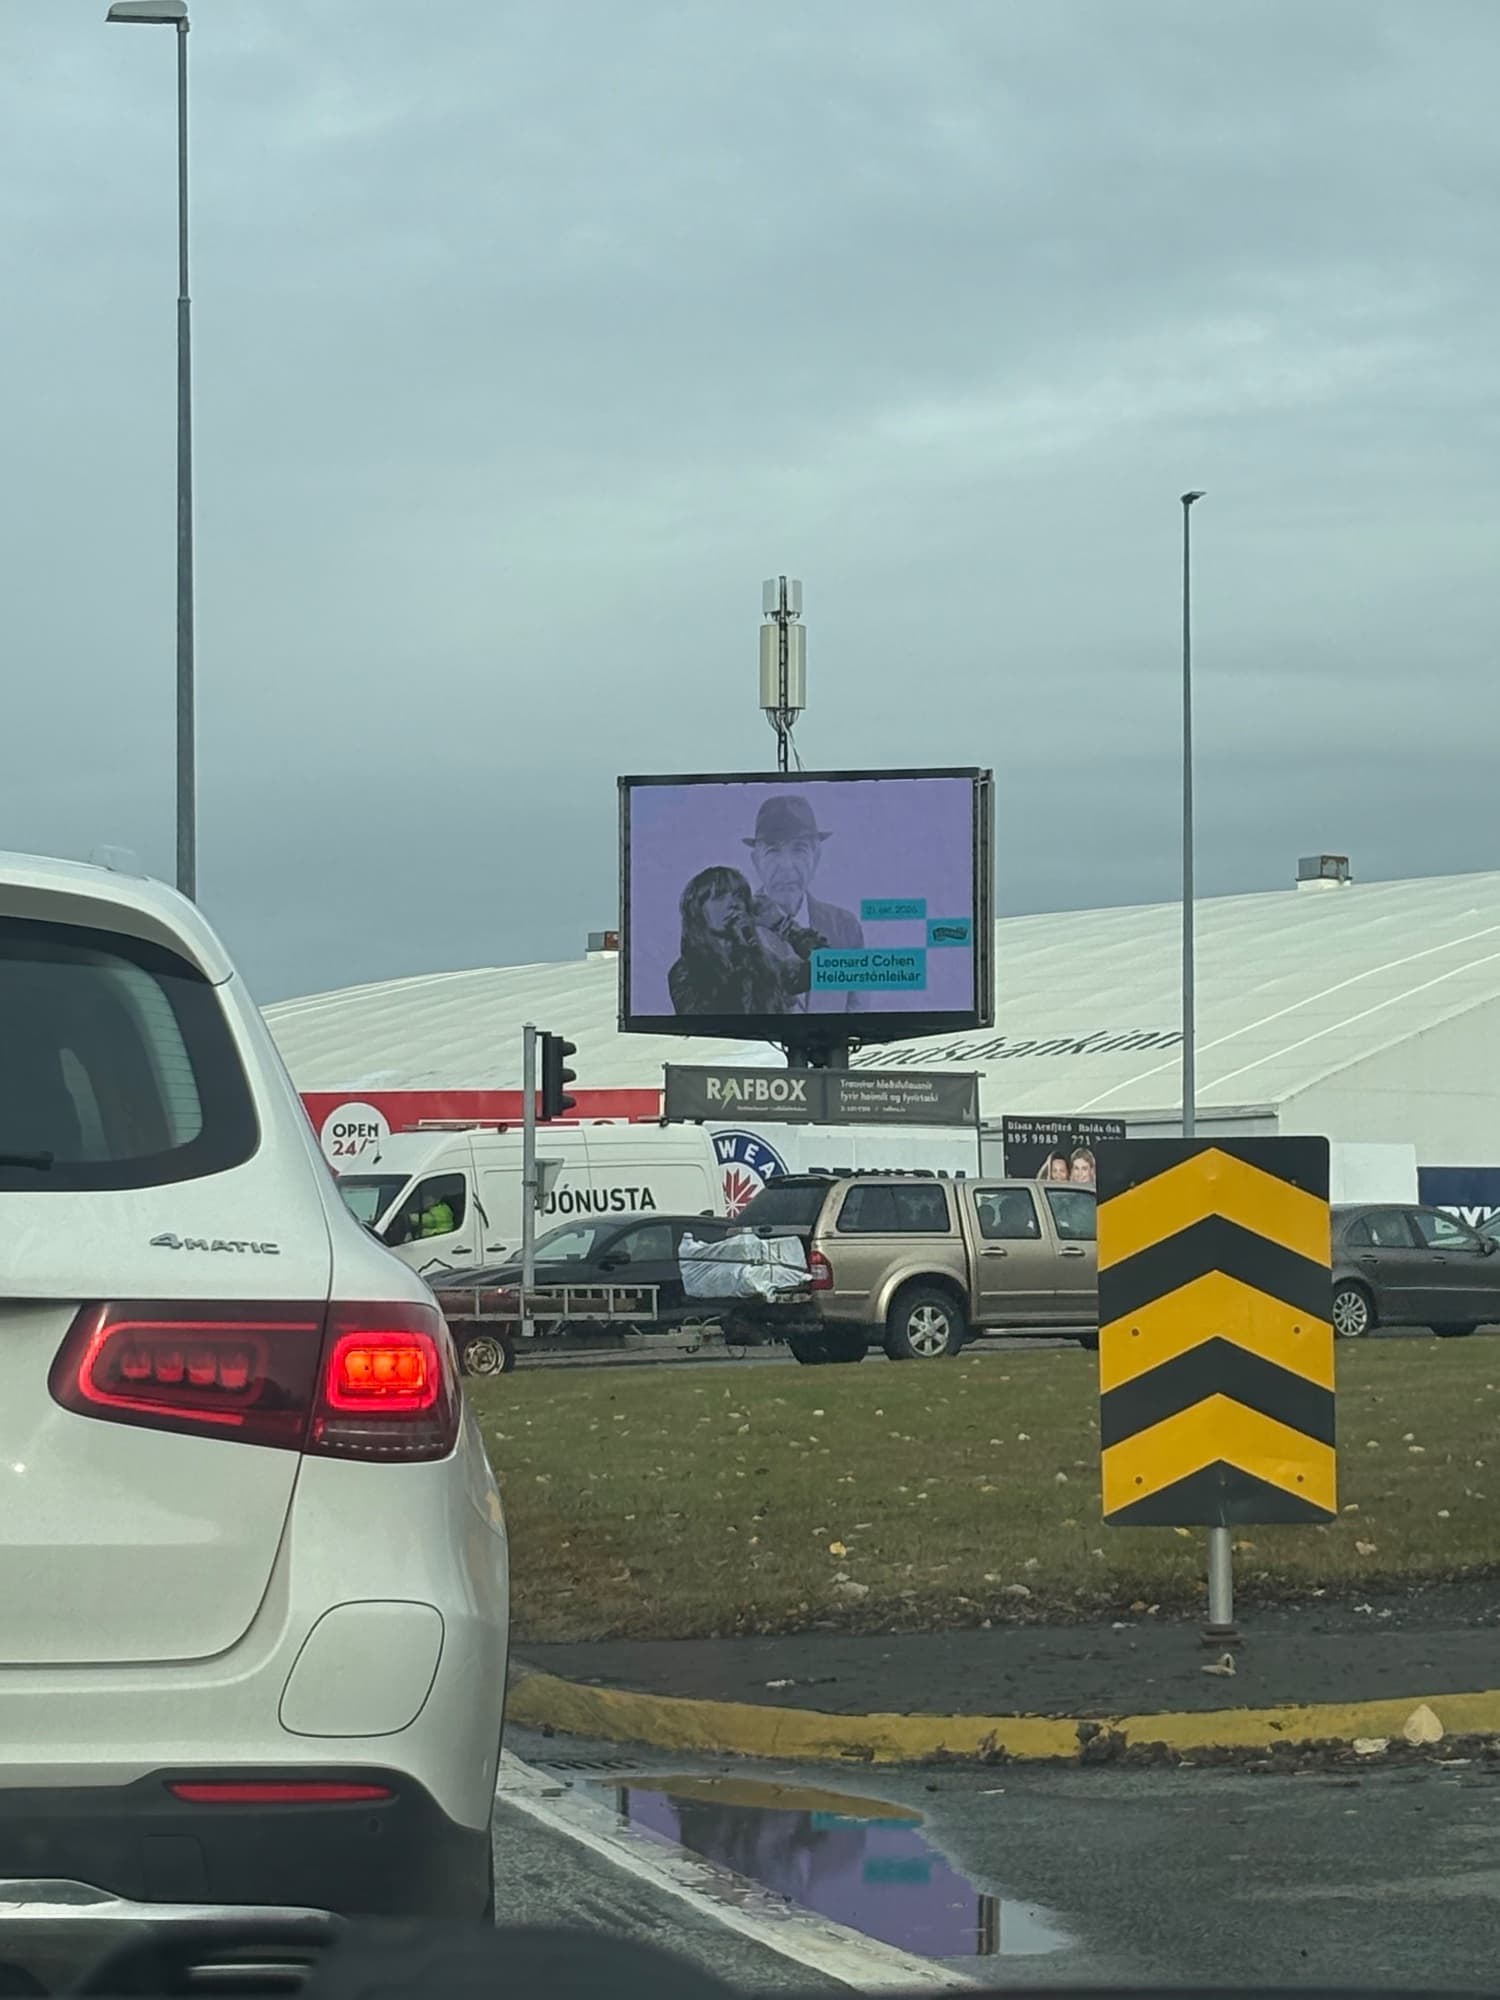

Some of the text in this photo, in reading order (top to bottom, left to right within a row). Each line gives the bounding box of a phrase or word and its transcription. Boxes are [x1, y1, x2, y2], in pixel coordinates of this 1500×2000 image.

[816, 954, 915, 968] Leonard Cohen
[849, 1030, 1184, 1068] andsbankinn
[706, 1077, 808, 1109] RAFBOX
[332, 1123, 379, 1138] OPEN
[332, 1138, 376, 1156] 24/
[544, 1183, 656, 1214] JÓNUSTA
[150, 1232, 281, 1255] 4MATIC
